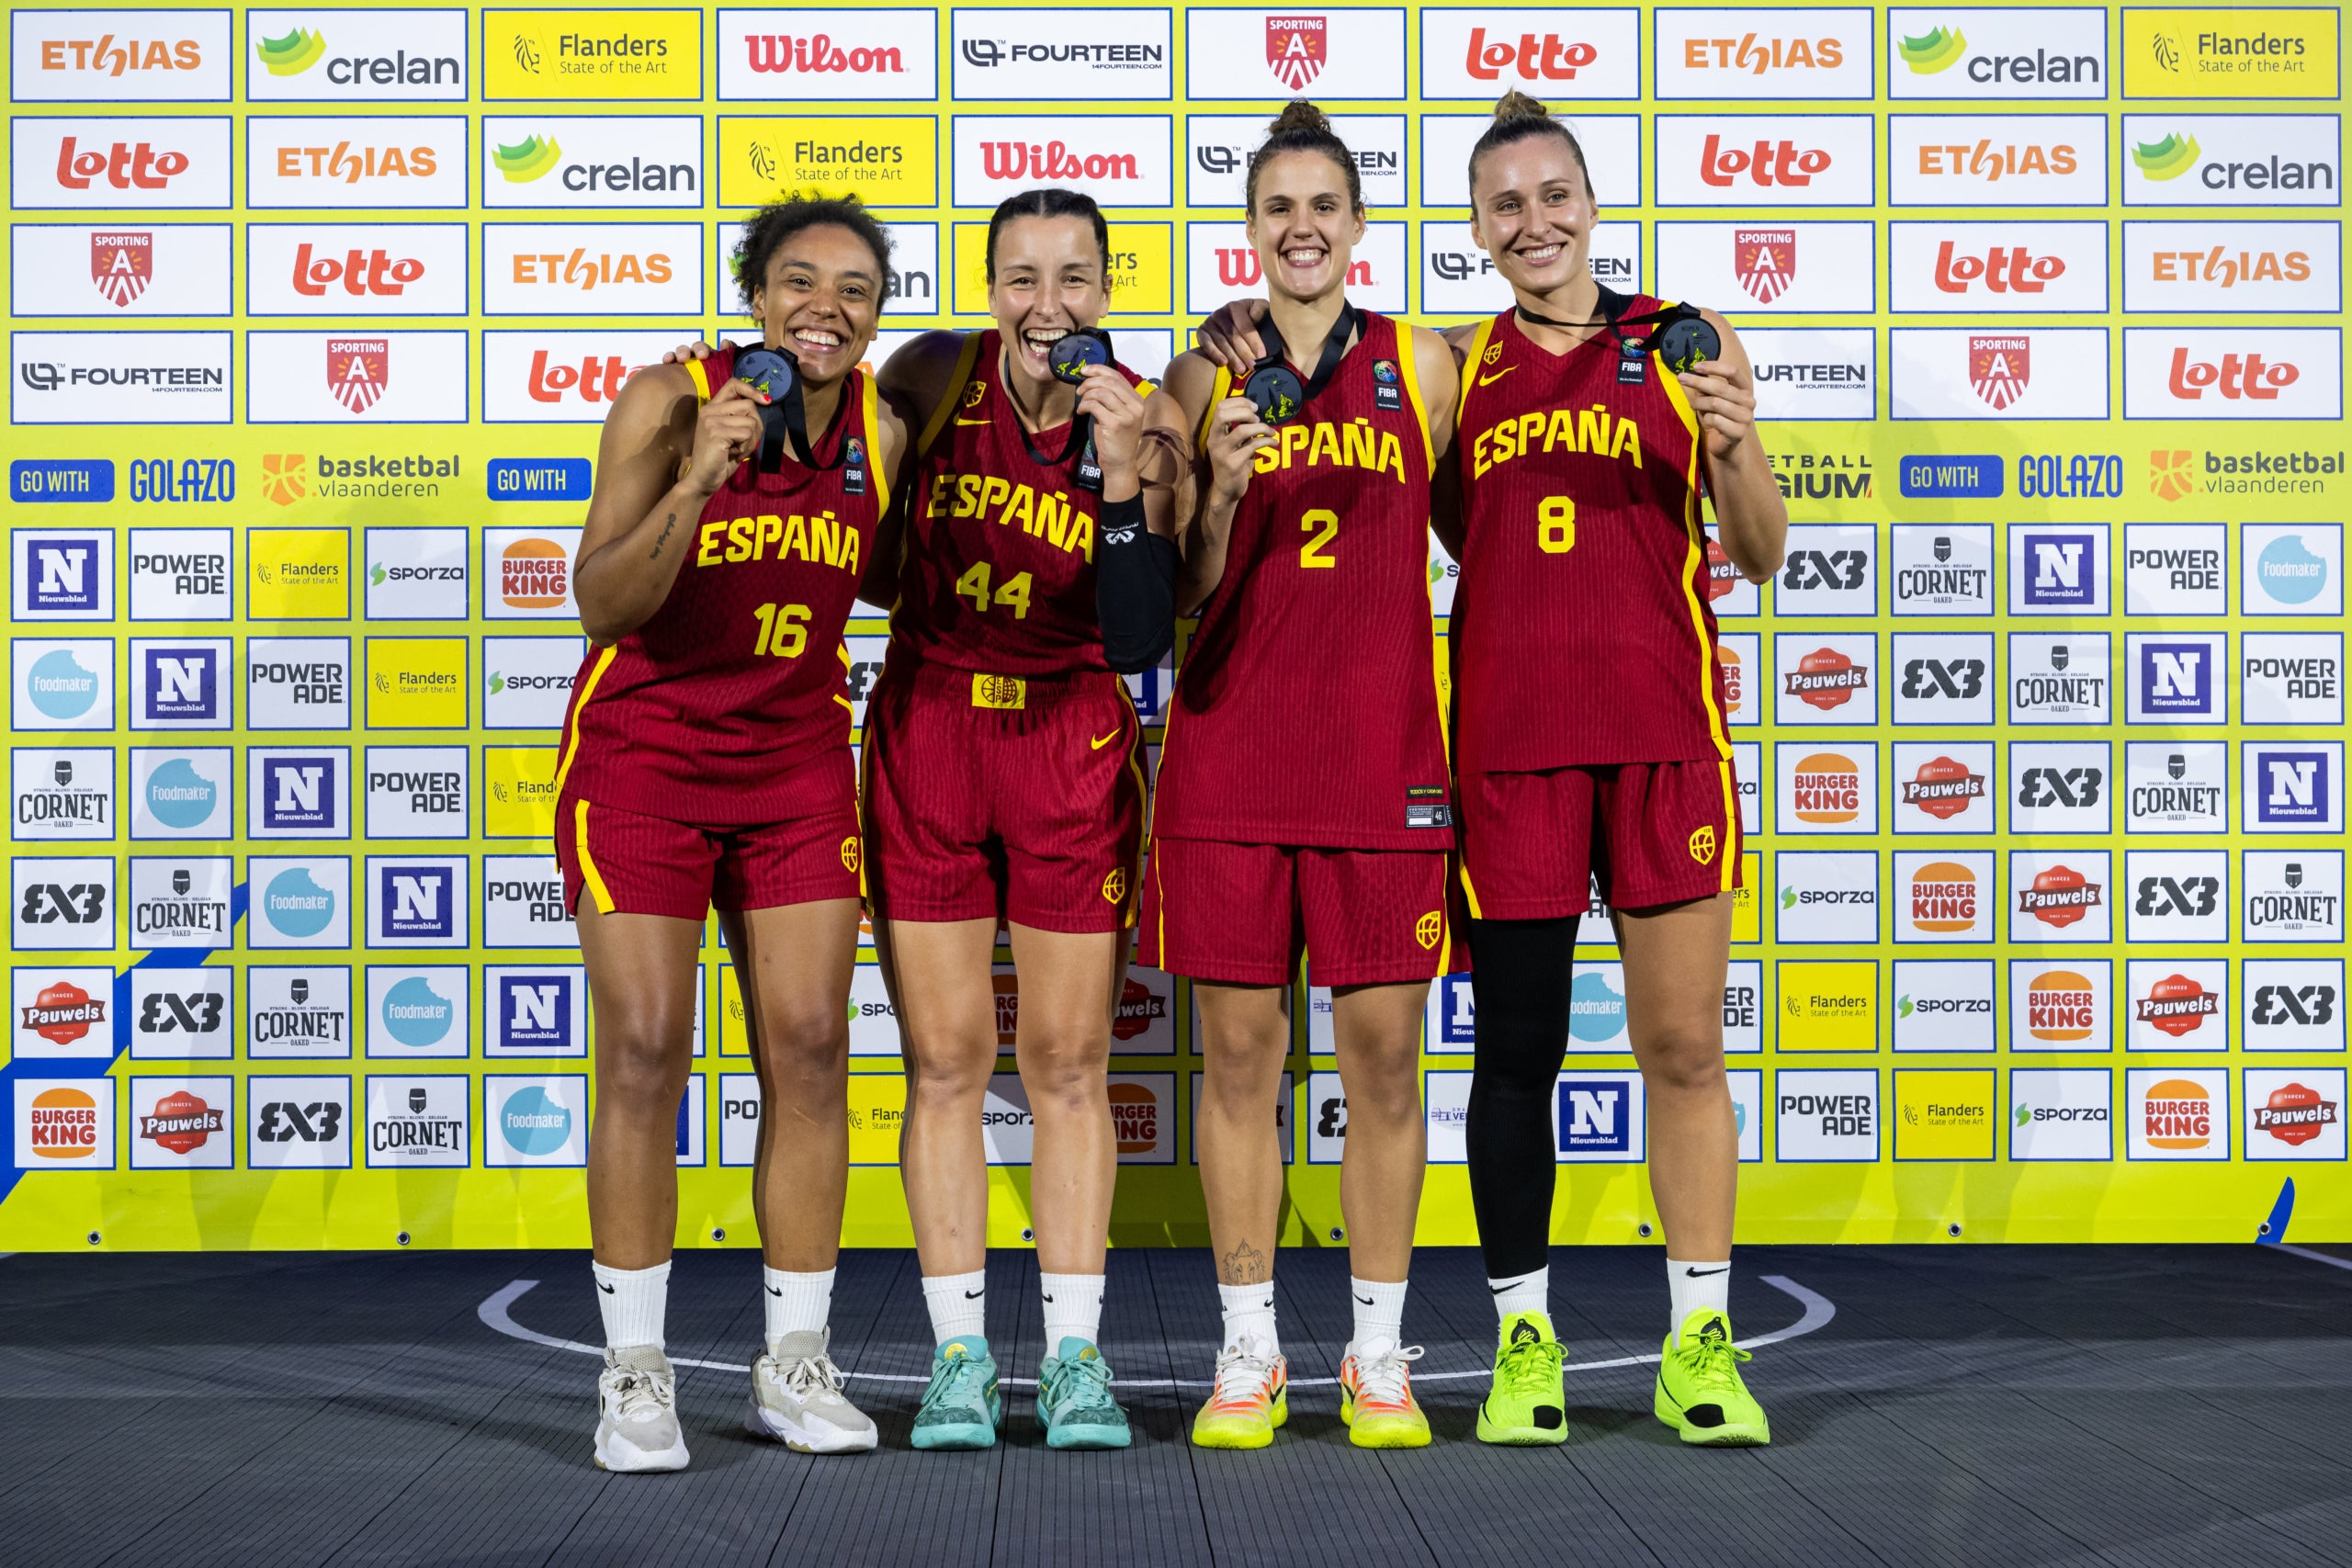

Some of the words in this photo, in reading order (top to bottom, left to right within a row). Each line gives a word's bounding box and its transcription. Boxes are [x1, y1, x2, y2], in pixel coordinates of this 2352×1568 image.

[1270, 20, 1324, 29] SPORTING
[560, 33, 668, 57] Flanders
[745, 34, 904, 73] Wilson
[1012, 44, 1162, 62] FOURTEEN
[2199, 32, 2305, 55] Flanders
[326, 50, 459, 85] crelan
[560, 61, 594, 73] State
[600, 61, 615, 73] of
[619, 61, 641, 73] the
[646, 61, 668, 73] Art
[1967, 49, 2099, 84] crelan
[795, 140, 903, 164] Flanders
[980, 141, 1139, 180] Wilson
[561, 156, 695, 191] crelan
[795, 167, 830, 180] State
[835, 167, 850, 180] of
[854, 167, 876, 180] the
[881, 167, 903, 180] Art
[2200, 155, 2333, 190] crelan
[95, 236, 149, 246] SPORTING
[1738, 233, 1792, 243] SPORTING
[331, 343, 385, 353] SPORTING
[1973, 340, 2027, 350] SPORTING
[72, 367, 222, 385] FOURTEEN
[528, 350, 648, 402] Lott
[1622, 362, 1643, 372] FIBA
[1755, 365, 1866, 381] URTEEN
[1378, 387, 1397, 399] FIBA
[1248, 417, 1406, 484] SPAÑA
[1474, 403, 1643, 480] ESPAÑA
[319, 455, 460, 479] basketbal
[1767, 455, 1872, 468] ETBALL
[2205, 451, 2344, 474] basketbal
[20, 470, 43, 493] GO
[47, 470, 90, 493] WITH
[130, 458, 235, 503] GOLAZO
[497, 468, 520, 491] GO
[524, 468, 567, 491] WITH
[846, 469, 862, 481] FIBA
[1081, 465, 1102, 479] FIBA
[1910, 466, 1933, 488] GO
[1937, 466, 1979, 488] WITH
[2018, 455, 2123, 499] GOLAZO
[926, 474, 1093, 565] ESPAÑA
[1538, 496, 1575, 554] 8
[696, 510, 859, 576] ESPAÑA
[1300, 509, 1339, 568] 2
[133, 554, 224, 574] POWER
[281, 562, 338, 575] Flanders
[502, 560, 567, 575] BURGER
[2129, 549, 2219, 570] POWER
[2264, 560, 2321, 577] Foodmaker
[175, 575, 224, 595] ADE
[502, 575, 567, 596] KING
[956, 560, 1033, 619] 44
[1899, 570, 1986, 600] CORNET
[2170, 570, 2219, 590] ADE
[753, 603, 812, 658] 16
[252, 663, 342, 683] POWER
[400, 671, 457, 684] Flanders
[2245, 659, 2335, 679] POWER
[34, 675, 92, 692] Foodmaker
[1791, 669, 1861, 690] Pauwels
[2287, 679, 2335, 699] ADE
[293, 683, 342, 704] ADE
[2017, 679, 2104, 709] CORNET
[2152, 698, 2200, 706] Nieuwsblad
[156, 704, 206, 712] Nieuwsblad
[369, 772, 460, 792] POWER
[1794, 774, 1859, 789] BURGER
[1908, 778, 1979, 799] Pauwels
[153, 784, 210, 801] Foodmaker
[1794, 789, 1859, 810] KING
[2133, 787, 2220, 818] CORNET
[19, 794, 107, 824] CORNET
[412, 793, 460, 813] ADE
[2268, 807, 2317, 816] Nieuwsblad
[1435, 811, 1442, 820] 46
[270, 893, 329, 909] Foodmaker
[1912, 884, 1976, 898] BURGER
[2025, 886, 2096, 908] Pauwels
[138, 903, 225, 933] CORNET
[1912, 898, 1976, 919] KING
[2250, 897, 2337, 927] CORNET
[1571, 1000, 1623, 1015] oodmaker
[1810, 995, 1867, 1008] Flanders
[2029, 992, 2093, 1007] BURGER
[2143, 996, 2213, 1016] Pauwels
[28, 1003, 99, 1024] Pauwels
[389, 1002, 447, 1019] Foodmaker
[2029, 1007, 2093, 1028] KING
[255, 1012, 344, 1043] CORNET
[1780, 1095, 1871, 1115] POWER
[1928, 1103, 1984, 1116] Flanders
[2145, 1101, 2211, 1116] BURGER
[2260, 1104, 2331, 1125] Pauwels
[31, 1110, 96, 1124] BURGER
[146, 1112, 218, 1134] Pauwels
[506, 1111, 565, 1128] Foodmaker
[1822, 1116, 1871, 1136] ADE
[2145, 1116, 2211, 1137] KING
[31, 1124, 96, 1145] KING
[373, 1121, 462, 1152] CORNET
[1569, 1136, 1618, 1145] Nieuwsblad
